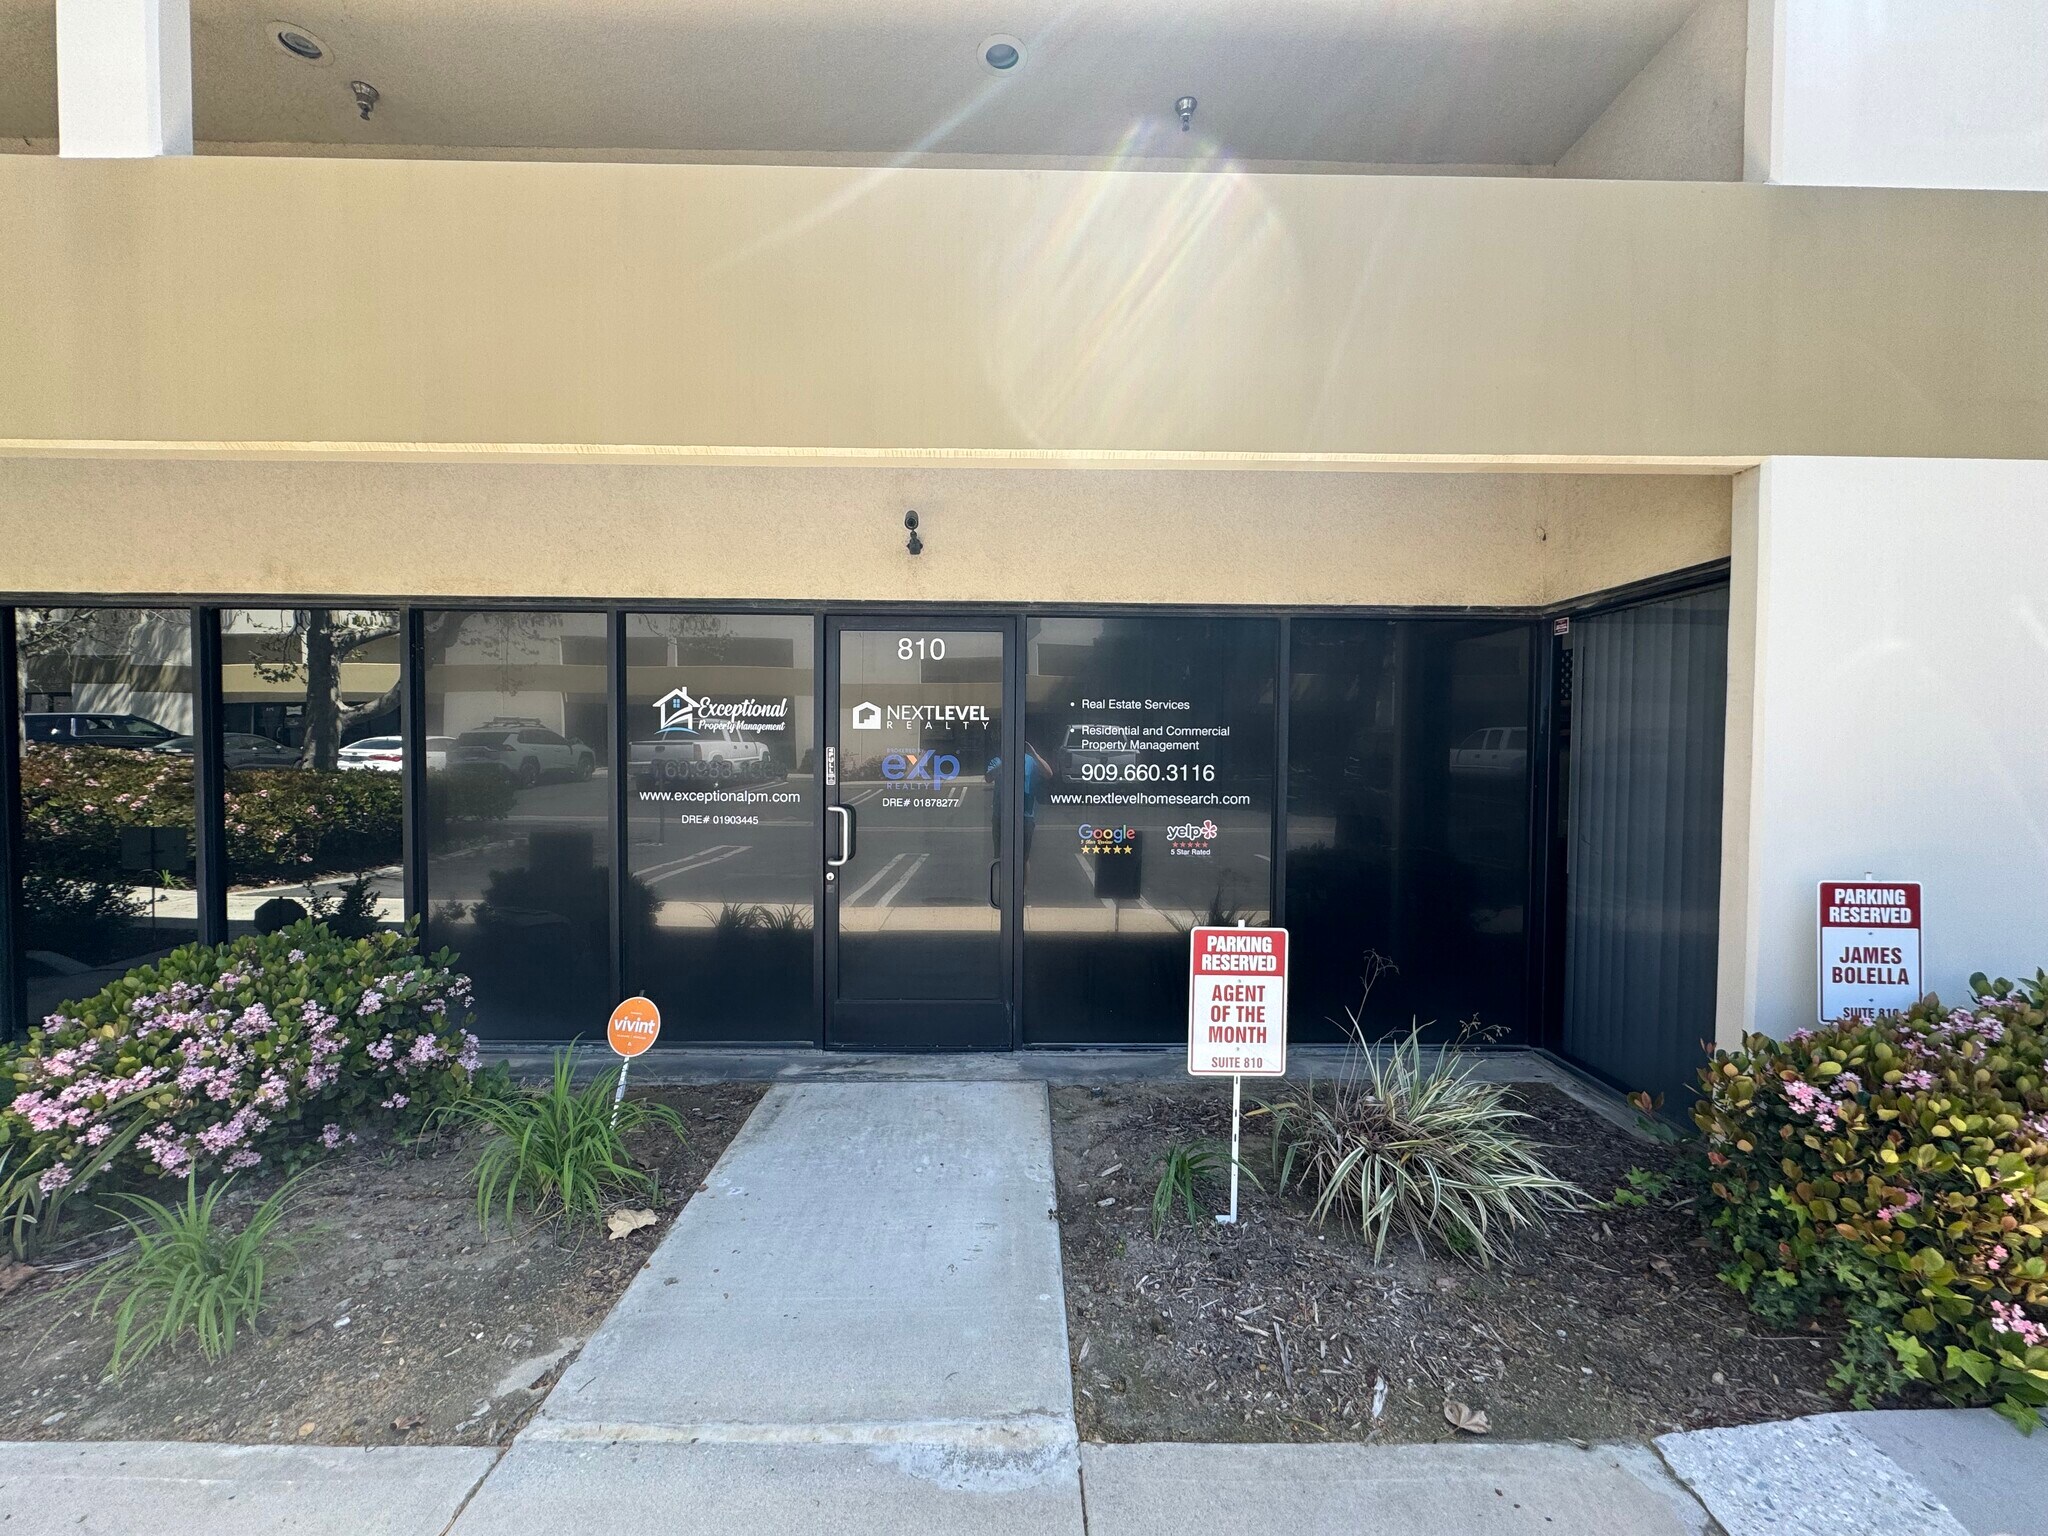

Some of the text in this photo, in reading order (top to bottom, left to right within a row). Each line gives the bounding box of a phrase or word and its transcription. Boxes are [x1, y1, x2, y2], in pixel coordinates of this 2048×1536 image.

[898, 638, 946, 660] 810
[698, 696, 788, 722] Exceptional
[887, 705, 990, 720] NEXTLEVEL
[1081, 699, 1190, 710] Real Estate Services
[698, 720, 786, 734] Property Management
[886, 721, 989, 730] REALTY
[1081, 725, 1230, 737] Residential and Commercial
[1081, 740, 1200, 752] Property Management
[1081, 764, 1215, 782] 909.660.3116
[886, 782, 930, 790] REALTY
[639, 790, 800, 804] www.exceptionalpm.com
[882, 798, 959, 807] DRE# 01878277
[1050, 792, 1250, 805] www.nextlevelhomesearch.com
[681, 814, 759, 825] DRE# 01903445
[1078, 823, 1136, 844] Google
[1166, 823, 1202, 841] yelp
[1170, 848, 1211, 856] 5 Star Rated
[1834, 888, 1906, 905] PARKING
[1829, 906, 1912, 923] RESERVED
[1207, 935, 1272, 953] PARKING
[1201, 954, 1277, 972] RESERVED
[1839, 946, 1902, 964] JAMES
[1832, 966, 1909, 985] BOLELLA
[1211, 984, 1266, 1002] AGENT
[1210, 1005, 1266, 1023] OF THE
[1843, 1007, 1875, 1019] SUITE
[614, 1016, 656, 1035] vivint
[1208, 1026, 1267, 1043] MONTH
[1211, 1056, 1263, 1068] SUITE 810
